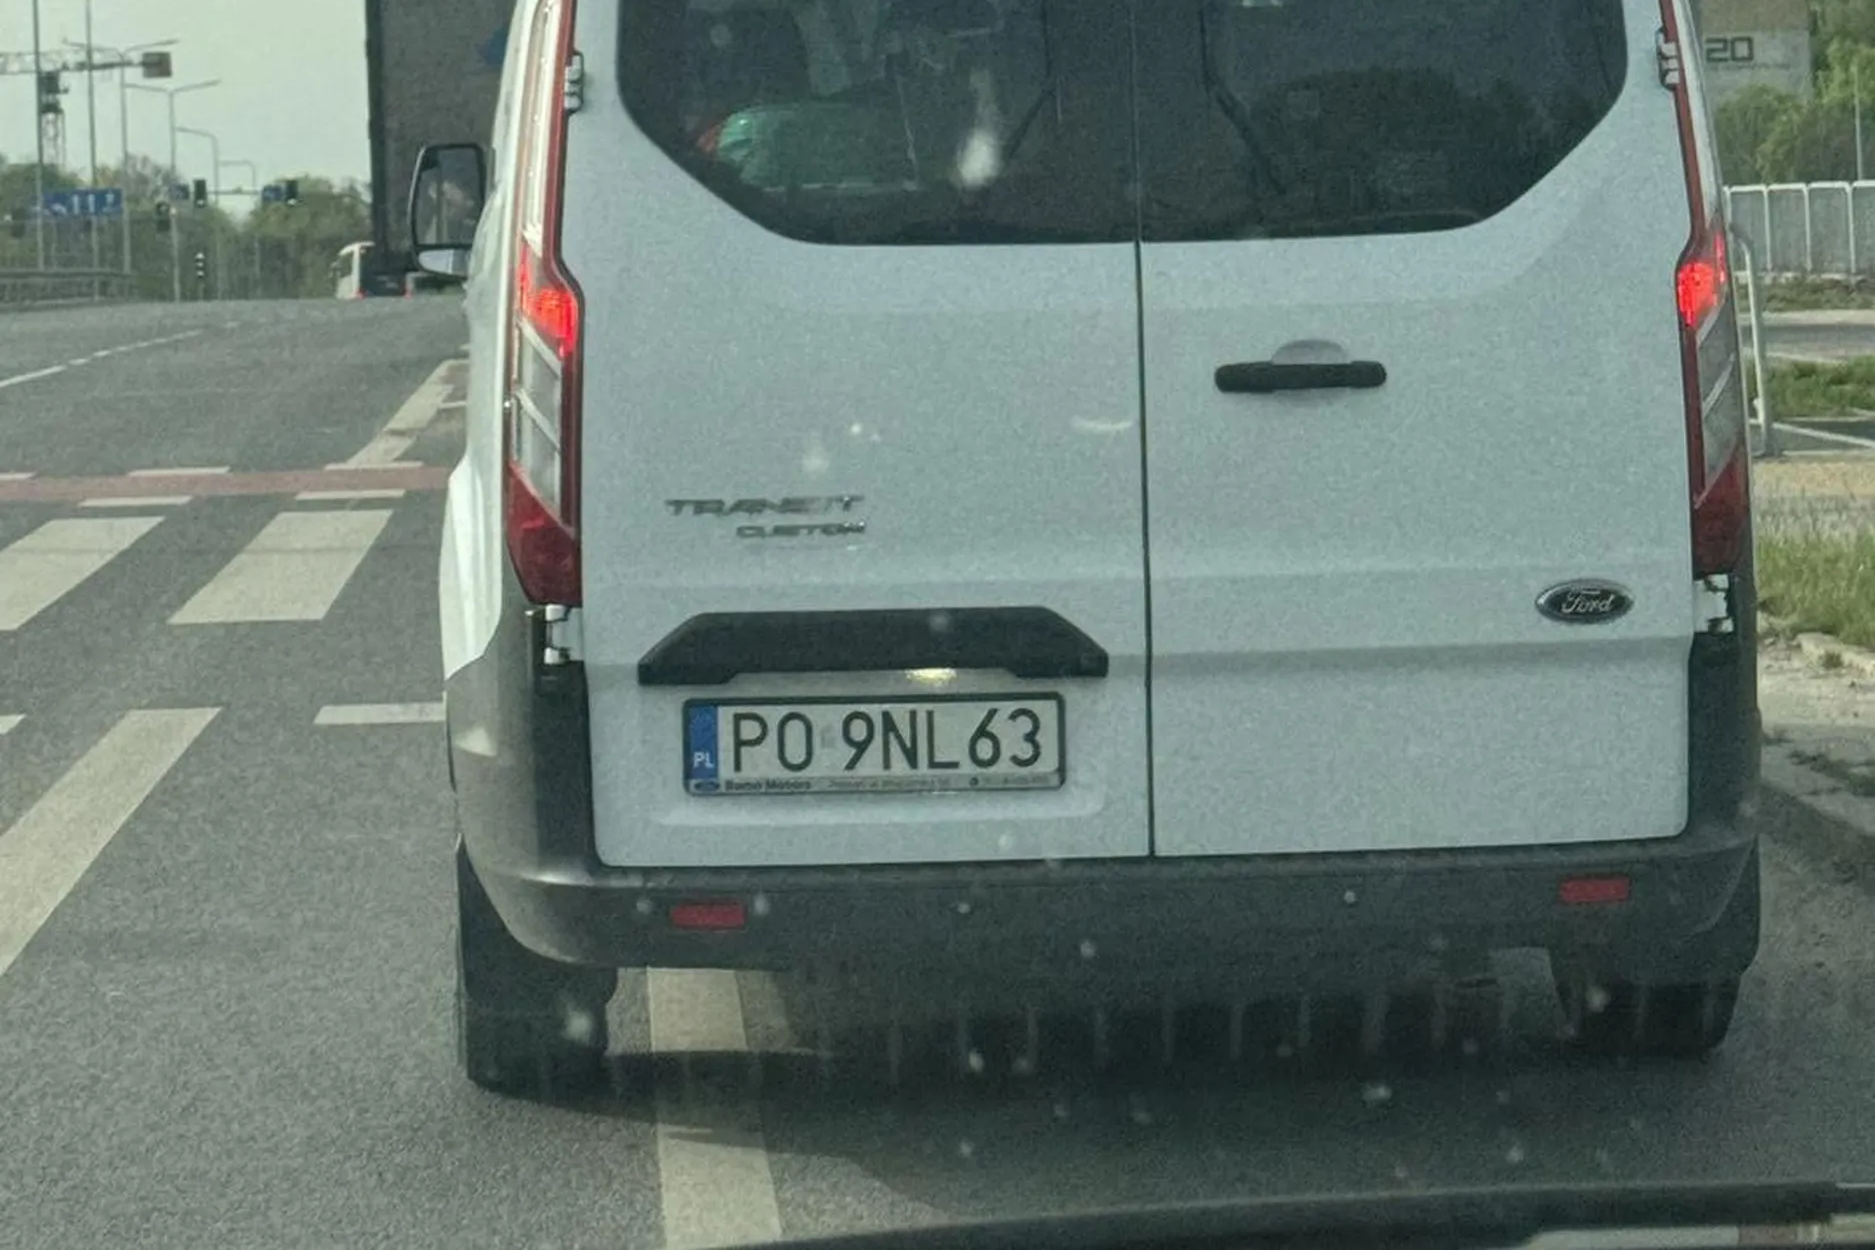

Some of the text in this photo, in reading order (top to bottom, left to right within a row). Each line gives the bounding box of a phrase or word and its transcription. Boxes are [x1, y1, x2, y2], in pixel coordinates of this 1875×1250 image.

[1561, 589, 1616, 614] Ford
[841, 707, 1042, 771] 9NL63
[693, 751, 715, 769] PL
